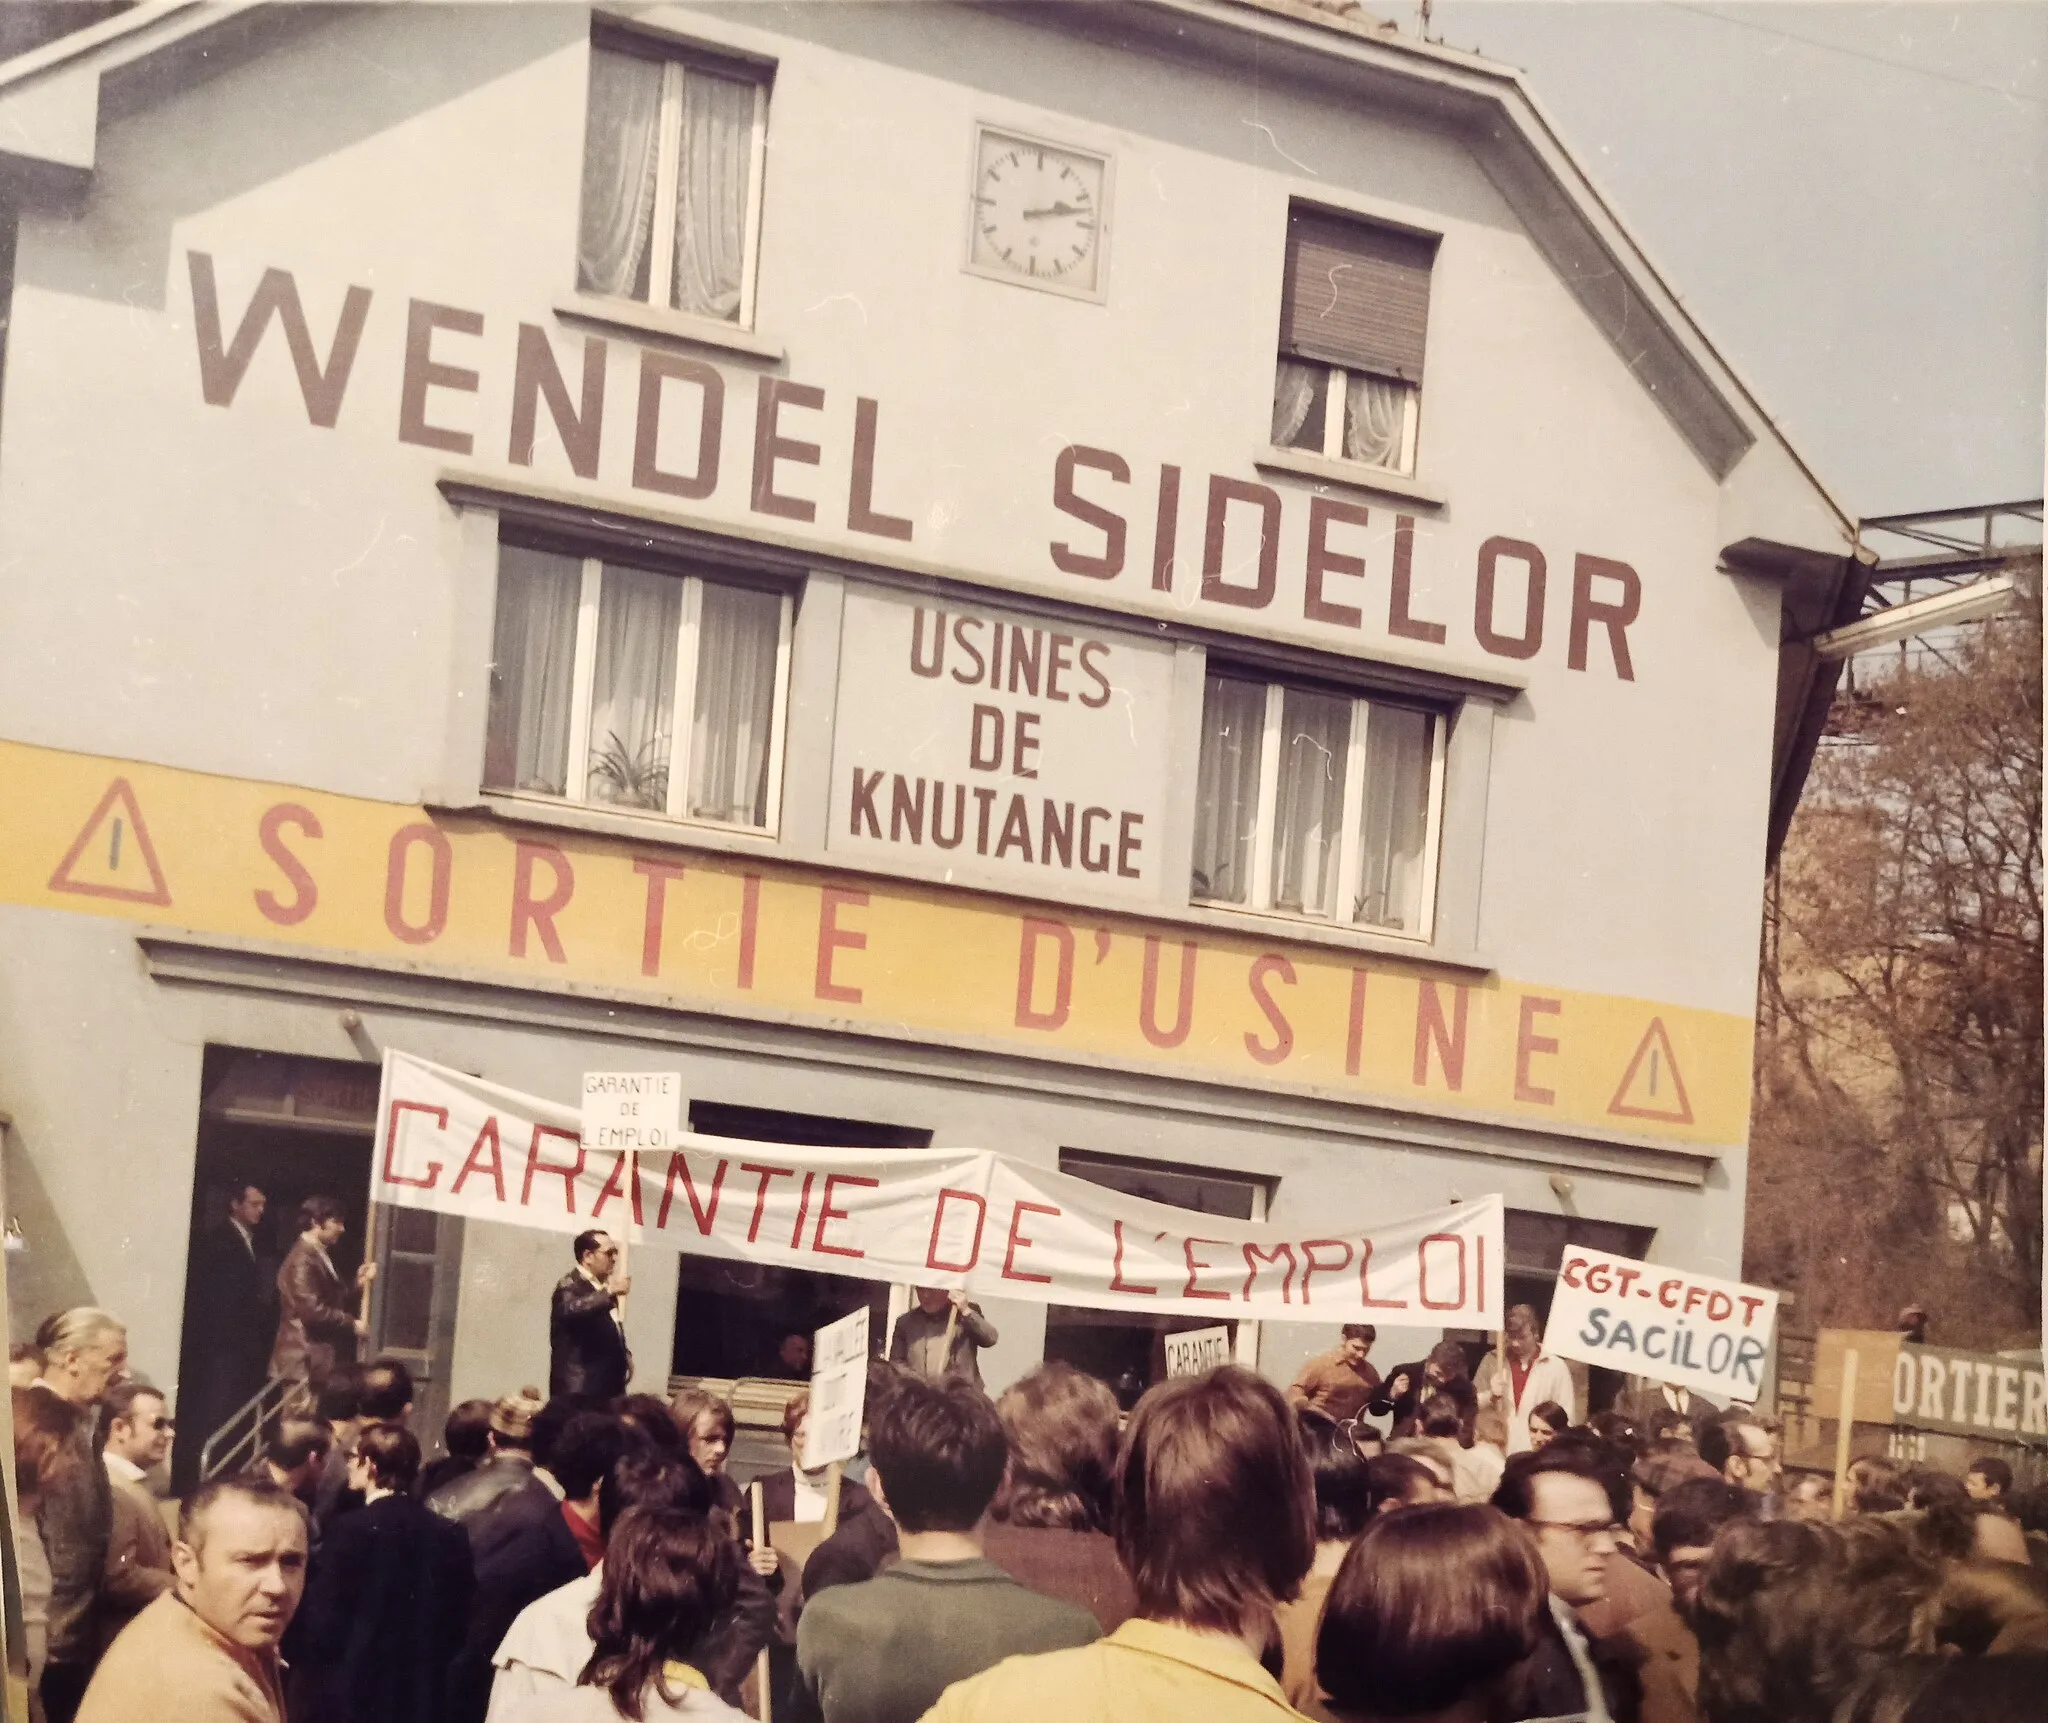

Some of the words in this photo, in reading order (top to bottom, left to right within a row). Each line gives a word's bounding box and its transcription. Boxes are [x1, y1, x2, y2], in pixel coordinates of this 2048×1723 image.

[187, 249, 913, 542] WENDEL
[1049, 444, 1642, 682] SIDELOR
[909, 606, 1112, 708] USINES
[969, 703, 1041, 779] DE
[850, 767, 1144, 880] KNUTANGE
[253, 804, 871, 1004] SORTIE
[1013, 916, 1561, 1106] D'USINE
[585, 1076, 671, 1095] GARANTIE
[620, 1102, 640, 1117] DE
[382, 1099, 880, 1258] GARANTIE
[925, 1187, 1061, 1284] DE
[1108, 1219, 1485, 1313] L'EMPLOI
[1562, 1257, 1765, 1328] CGT-CFDT
[1892, 1351, 2047, 1435] ORTIER
